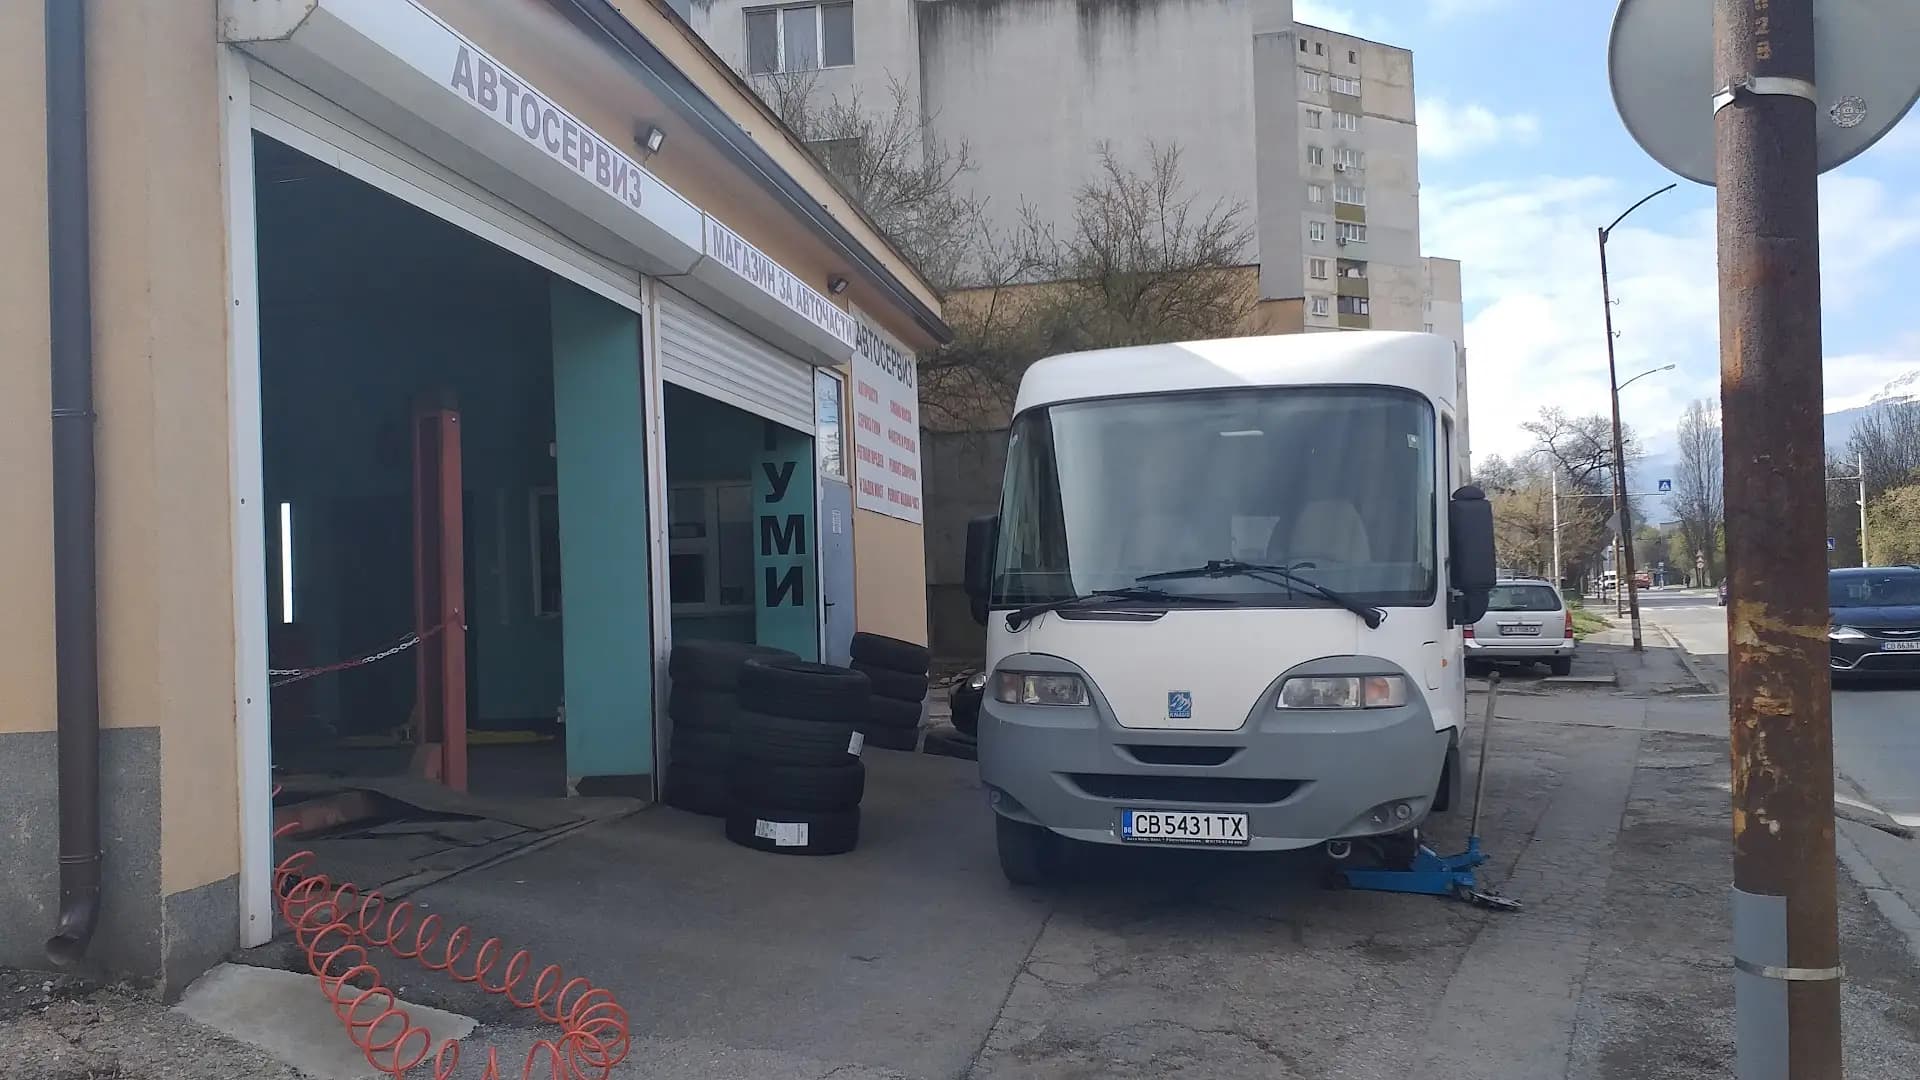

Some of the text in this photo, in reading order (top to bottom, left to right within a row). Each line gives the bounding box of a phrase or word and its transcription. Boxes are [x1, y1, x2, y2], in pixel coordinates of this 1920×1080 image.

[450, 44, 642, 209] АВТОСЕРВИЗ
[712, 224, 855, 346] МАГАЗИН ЗА АВТОЧАСТИ
[856, 320, 912, 389] АВТОСЕРВИЗ
